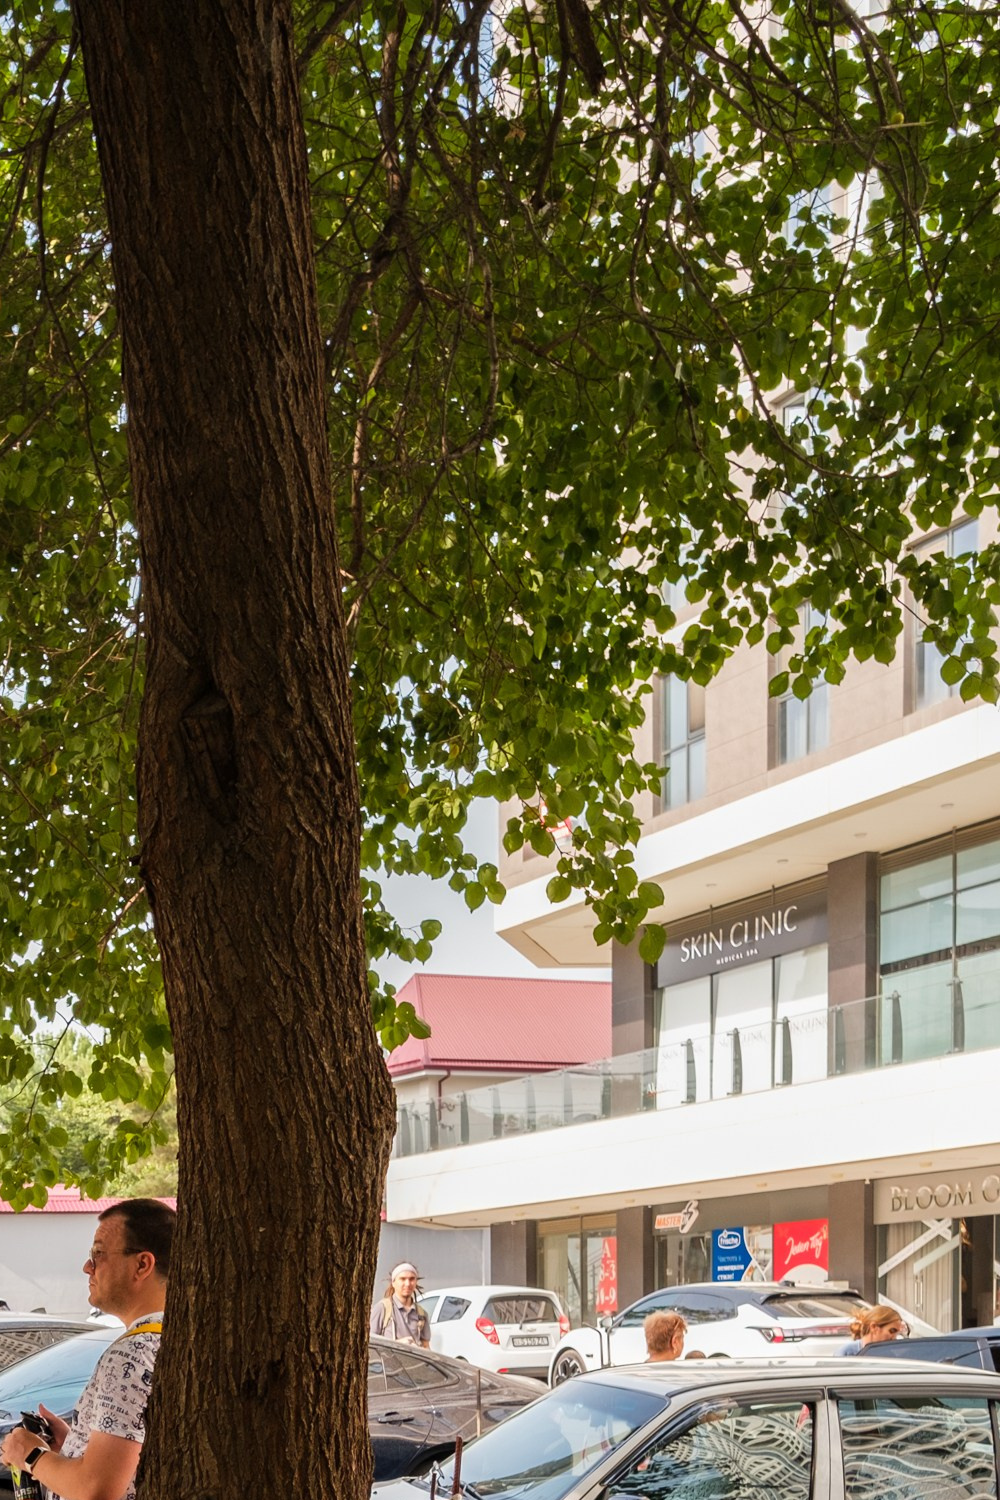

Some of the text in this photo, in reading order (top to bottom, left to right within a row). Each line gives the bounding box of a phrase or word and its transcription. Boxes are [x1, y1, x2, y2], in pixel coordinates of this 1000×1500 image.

[680, 905, 798, 963] SKIN CLINIC
[716, 953, 743, 965] MEDICAL
[890, 1181, 974, 1212] BLOOM
[657, 1215, 681, 1227] MASTER
